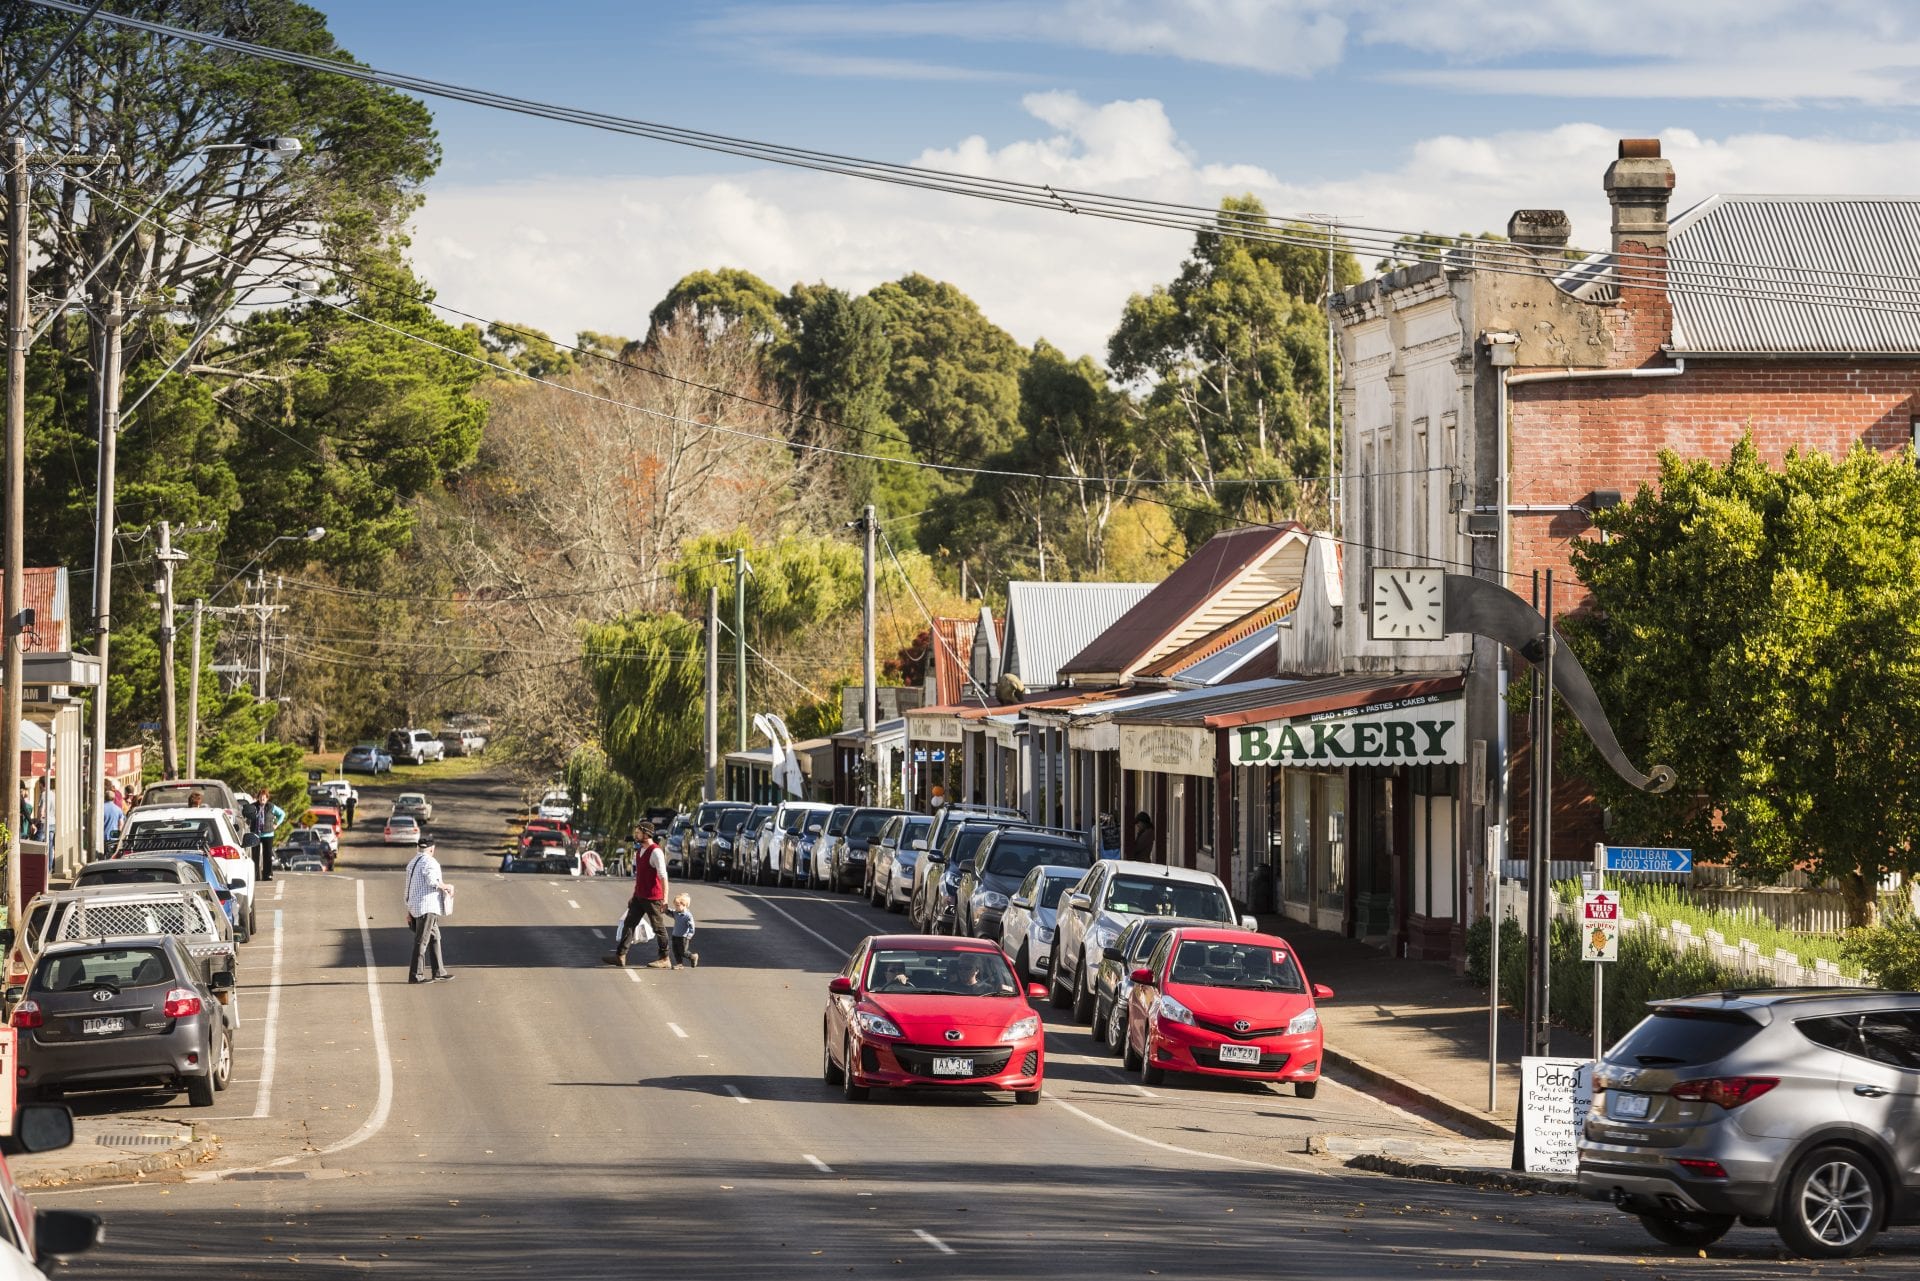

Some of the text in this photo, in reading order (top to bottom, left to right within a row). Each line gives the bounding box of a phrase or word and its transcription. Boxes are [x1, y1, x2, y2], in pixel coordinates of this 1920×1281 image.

[1311, 694, 1440, 721] BREAD PIES PASTIES CAKES etc.
[1236, 720, 1456, 762] BAKERY
[1621, 849, 1669, 861] COLLIBAN
[1615, 859, 1673, 870] FOOD STORE
[1275, 951, 1286, 962] P
[1536, 1065, 1582, 1088] Petrol
[1529, 1091, 1592, 1105] Produce Store
[1527, 1103, 1545, 1111] 2nd
[1548, 1105, 1571, 1114] Hand
[1543, 1115, 1583, 1126] Firewood
[1534, 1126, 1562, 1139] Scrap
[1546, 1139, 1573, 1147] Coffee
[1549, 1156, 1571, 1165] Eggs
